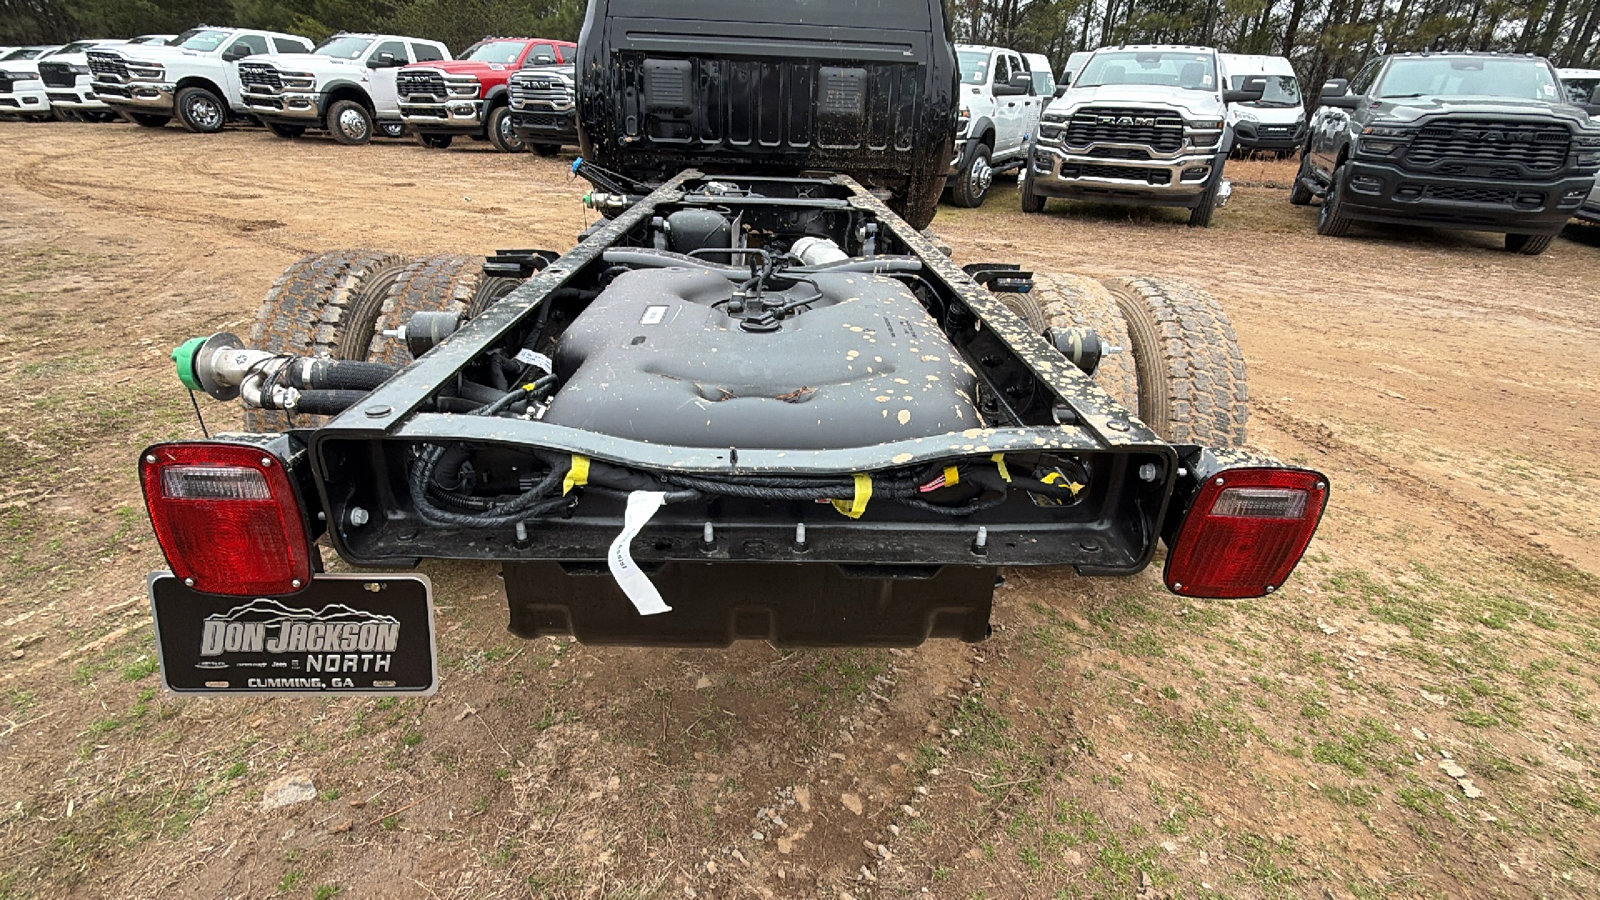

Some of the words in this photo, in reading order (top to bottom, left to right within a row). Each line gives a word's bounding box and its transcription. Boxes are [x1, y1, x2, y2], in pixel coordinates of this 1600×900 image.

[1098, 116, 1155, 126] RAM
[1458, 129, 1534, 142] RAM
[200, 620, 266, 657] DON
[266, 620, 400, 654] JACKSON
[306, 654, 391, 673] NORTH
[247, 677, 327, 689] CUMMING,
[331, 678, 355, 688] GA
